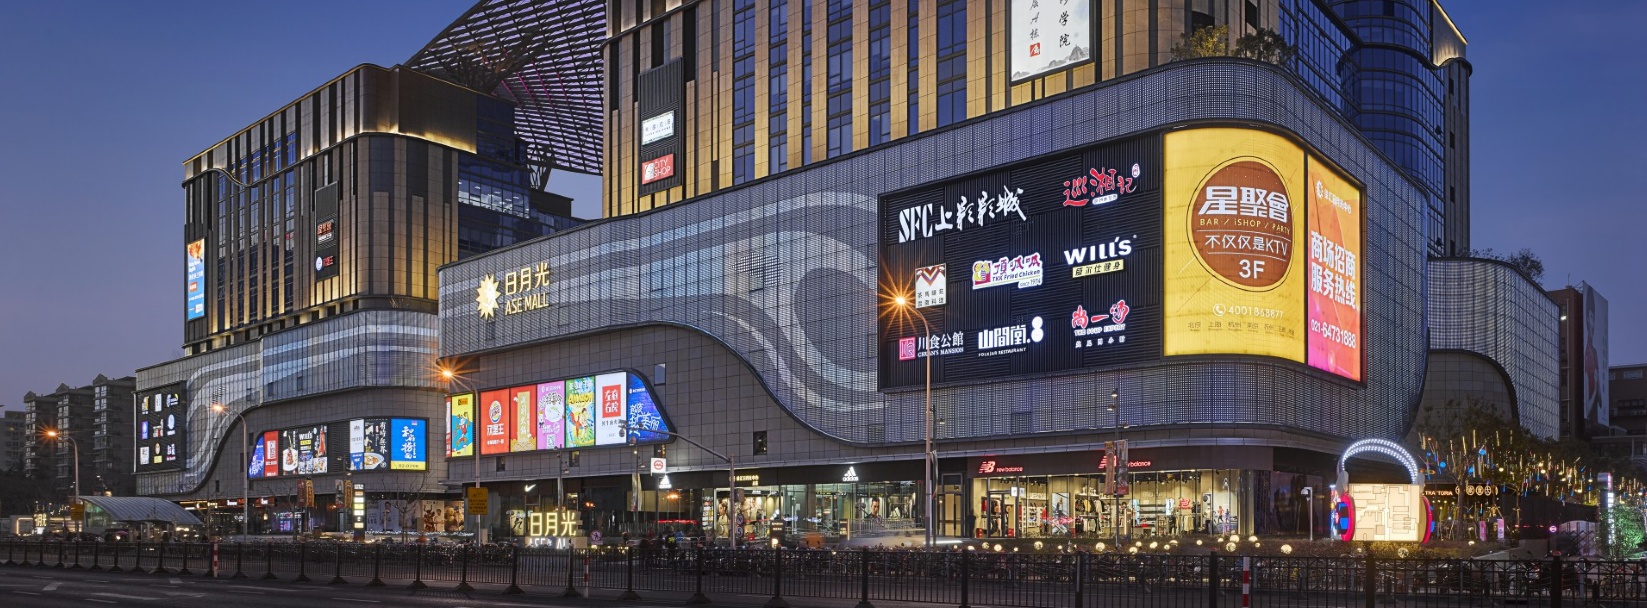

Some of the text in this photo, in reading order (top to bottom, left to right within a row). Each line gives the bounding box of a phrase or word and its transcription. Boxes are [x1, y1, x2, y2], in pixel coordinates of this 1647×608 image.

[654, 158, 668, 169] CITY
[654, 165, 671, 178] SHOP
[1198, 186, 1289, 223] 星聚會
[899, 203, 933, 243] SFC
[1200, 218, 1290, 235] BAR iSHOP PARTY
[1205, 234, 1288, 256] 不仅仅是KTV
[1311, 230, 1356, 280] 商场招商
[993, 253, 1041, 276] 頂呱呱
[1004, 272, 1019, 281] Fried
[1019, 269, 1041, 278] Chicken
[1239, 259, 1265, 279] 3F
[504, 262, 549, 296] 日月光
[1311, 262, 1357, 309] 服务热线
[505, 292, 549, 315] ASE MALL
[917, 330, 964, 351] 川食公館
[978, 324, 1027, 350] 山間堂
[1311, 319, 1357, 348] 021-64731888
[940, 347, 964, 355] MANSION
[998, 347, 1027, 355] RESTAURANT
[530, 510, 577, 537] 日月光
